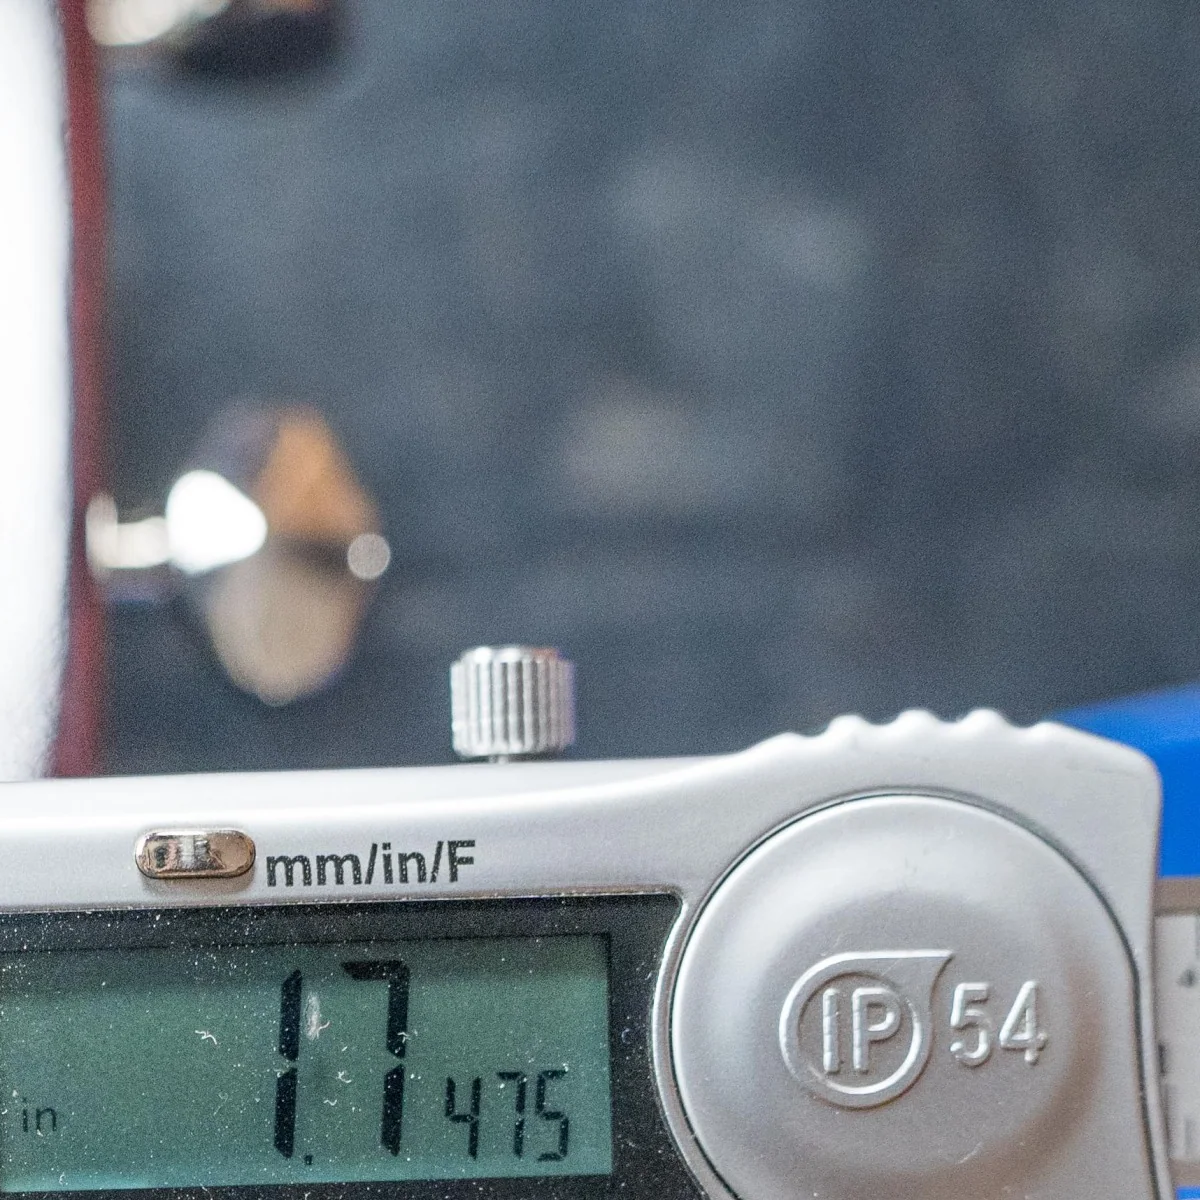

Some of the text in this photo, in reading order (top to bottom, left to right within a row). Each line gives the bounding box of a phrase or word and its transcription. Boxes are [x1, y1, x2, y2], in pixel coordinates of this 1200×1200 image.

[266, 839, 477, 888] mm/in/F
[821, 979, 1048, 1074] IP 54
[20, 1099, 59, 1134] in
